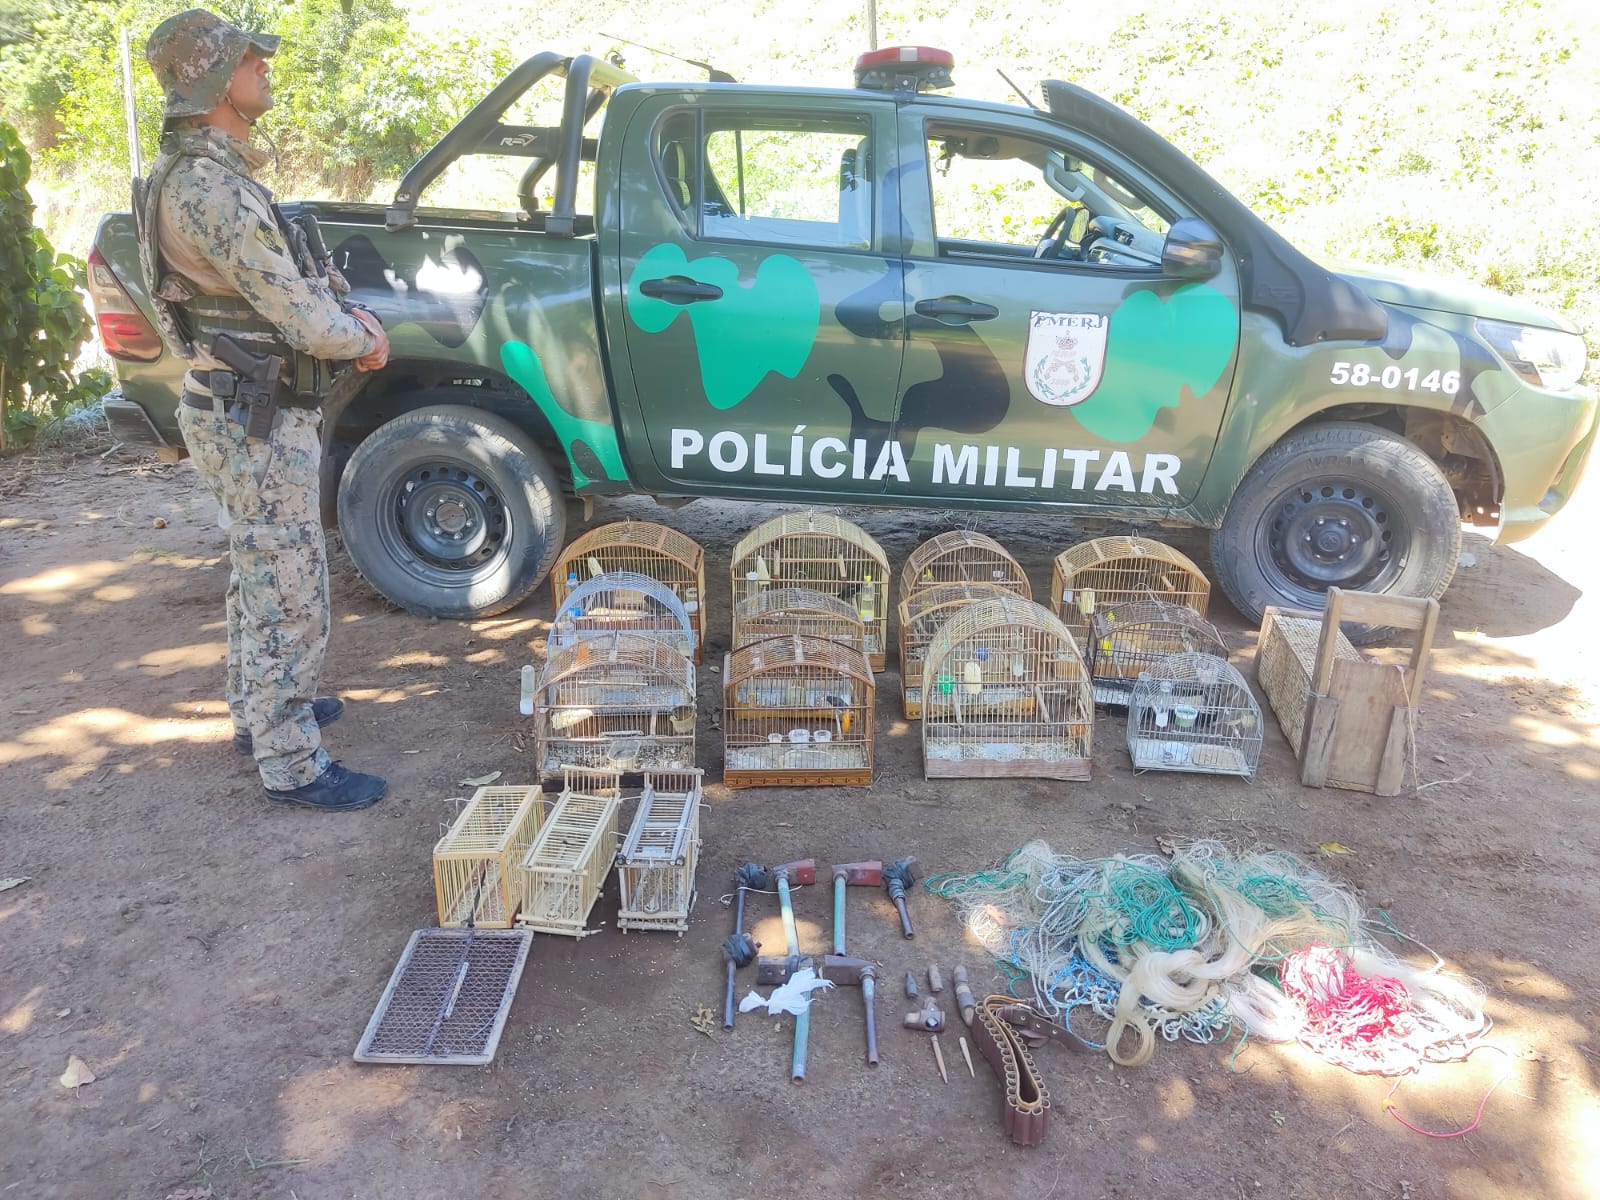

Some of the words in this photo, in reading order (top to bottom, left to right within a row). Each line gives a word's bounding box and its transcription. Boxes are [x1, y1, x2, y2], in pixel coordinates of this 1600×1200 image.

[1330, 362, 1461, 394] 58-0146
[671, 425, 910, 482] POLÍCIA
[932, 443, 1182, 495] MILITAR
